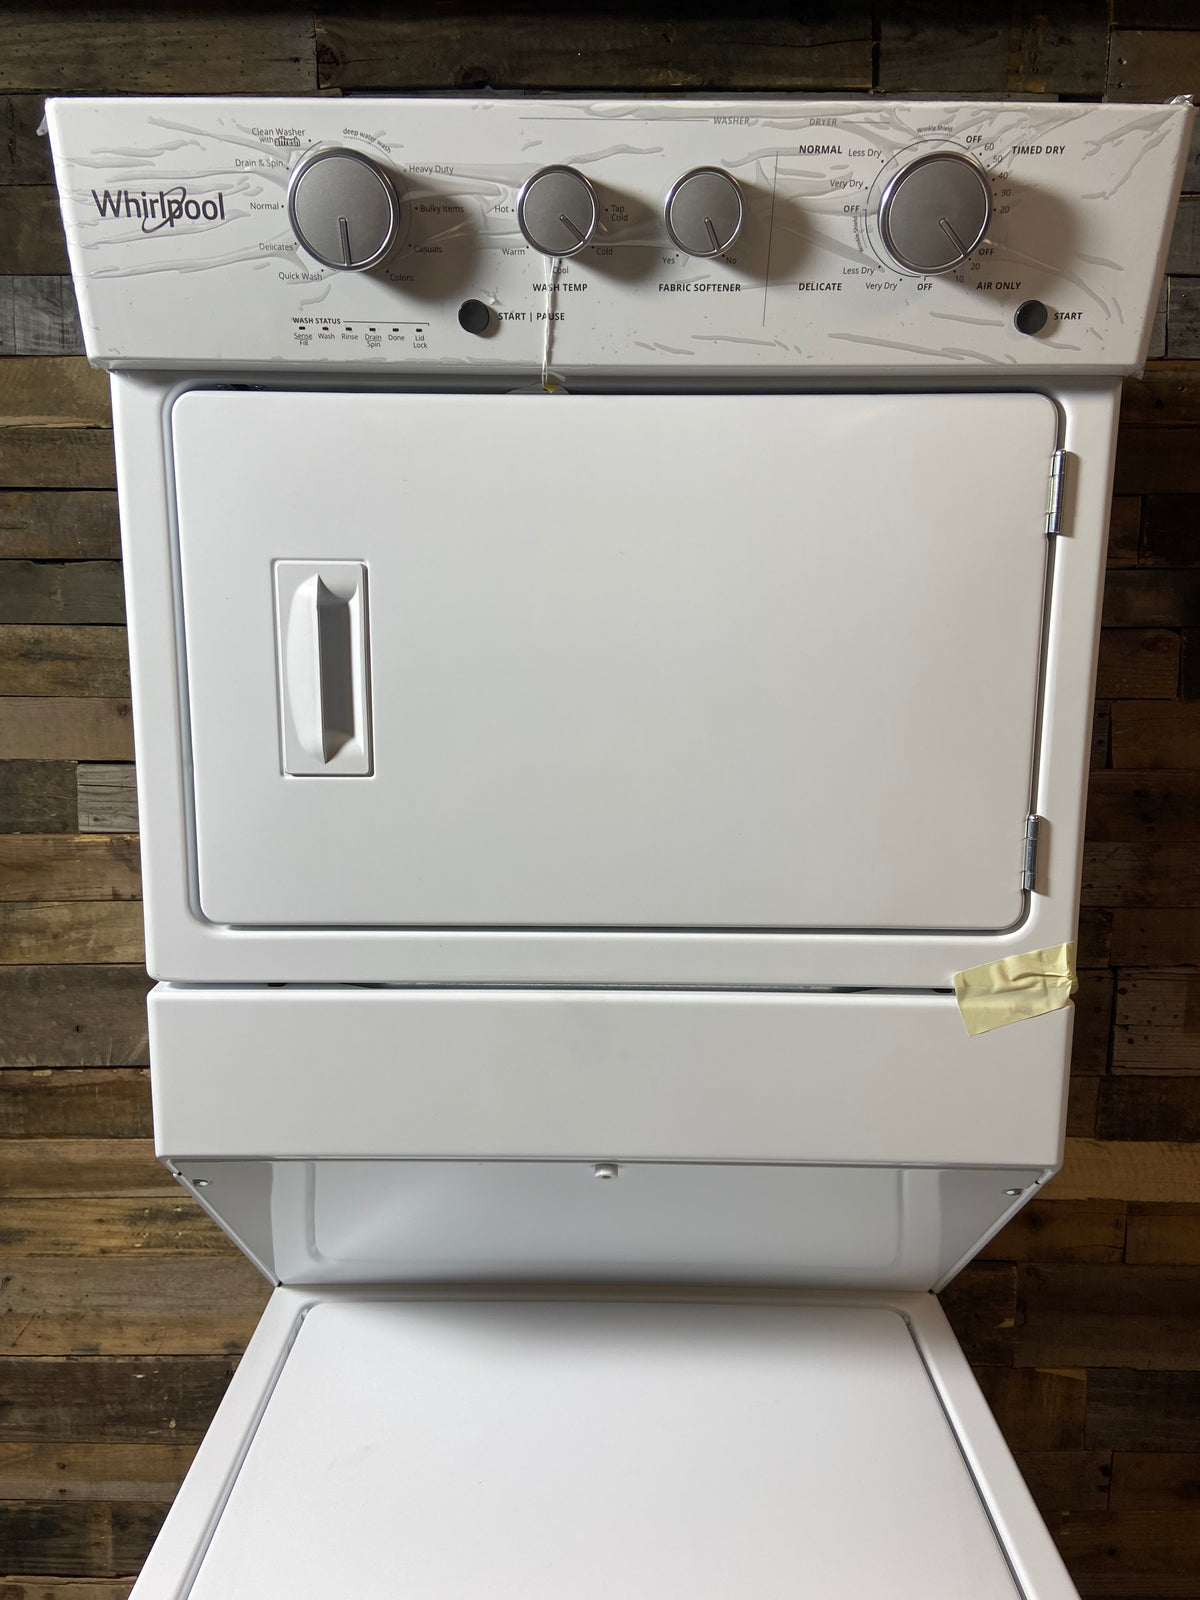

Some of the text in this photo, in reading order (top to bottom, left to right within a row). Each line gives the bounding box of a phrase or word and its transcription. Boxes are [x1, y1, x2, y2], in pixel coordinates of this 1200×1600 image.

[713, 116, 750, 125] WASHER
[809, 117, 837, 127] DRYER
[251, 127, 306, 136] Clean Washer
[342, 127, 392, 153] deep water wash
[965, 134, 982, 144] OFF
[799, 145, 843, 154] NORMAL
[984, 142, 995, 151] 60
[1011, 145, 1066, 155] TIMED DRY
[848, 148, 882, 159] Less Dry
[234, 158, 284, 169] Drain & Spin
[992, 155, 1003, 164] 50
[408, 164, 455, 175] Heavy Duty
[997, 171, 1009, 180] 40
[830, 178, 864, 191] Very Dry
[1001, 188, 1012, 198] 30
[91, 186, 226, 233] Whirlpool
[250, 202, 279, 211] Normal
[419, 204, 465, 215] Bulky Items
[494, 204, 509, 213] Hot
[610, 204, 625, 215] Tap
[843, 204, 861, 213] OFF
[1000, 205, 1011, 215] 20
[611, 212, 629, 222] Cold
[258, 242, 294, 251] Delicates
[413, 244, 443, 254] Casuals
[501, 247, 526, 256] Warm
[596, 246, 614, 256] Cold
[978, 247, 995, 256] OFF
[662, 256, 676, 265] Yes
[725, 256, 738, 265] No
[842, 265, 875, 276] Less Dry
[970, 262, 981, 272] 20
[278, 271, 323, 281] Quick Wash
[390, 272, 415, 283] Colors
[954, 274, 964, 284] 10
[562, 283, 588, 292] TEMP
[658, 283, 742, 293] FABRIC SOFTENER
[799, 282, 842, 293] DELICATE
[865, 281, 898, 292] Very Dry
[917, 282, 933, 293] OFF
[976, 281, 1022, 292] AIR ONLY
[292, 317, 314, 325] WASH
[498, 312, 527, 321] START
[536, 312, 565, 321] PAUSE
[1053, 311, 1083, 321] START
[293, 332, 313, 340] Sense
[317, 332, 336, 340] Wash
[341, 333, 359, 341] Rinse
[364, 333, 382, 341] Drain
[388, 334, 405, 342] Done
[366, 341, 381, 349] Spin
[413, 342, 428, 350] Lock
